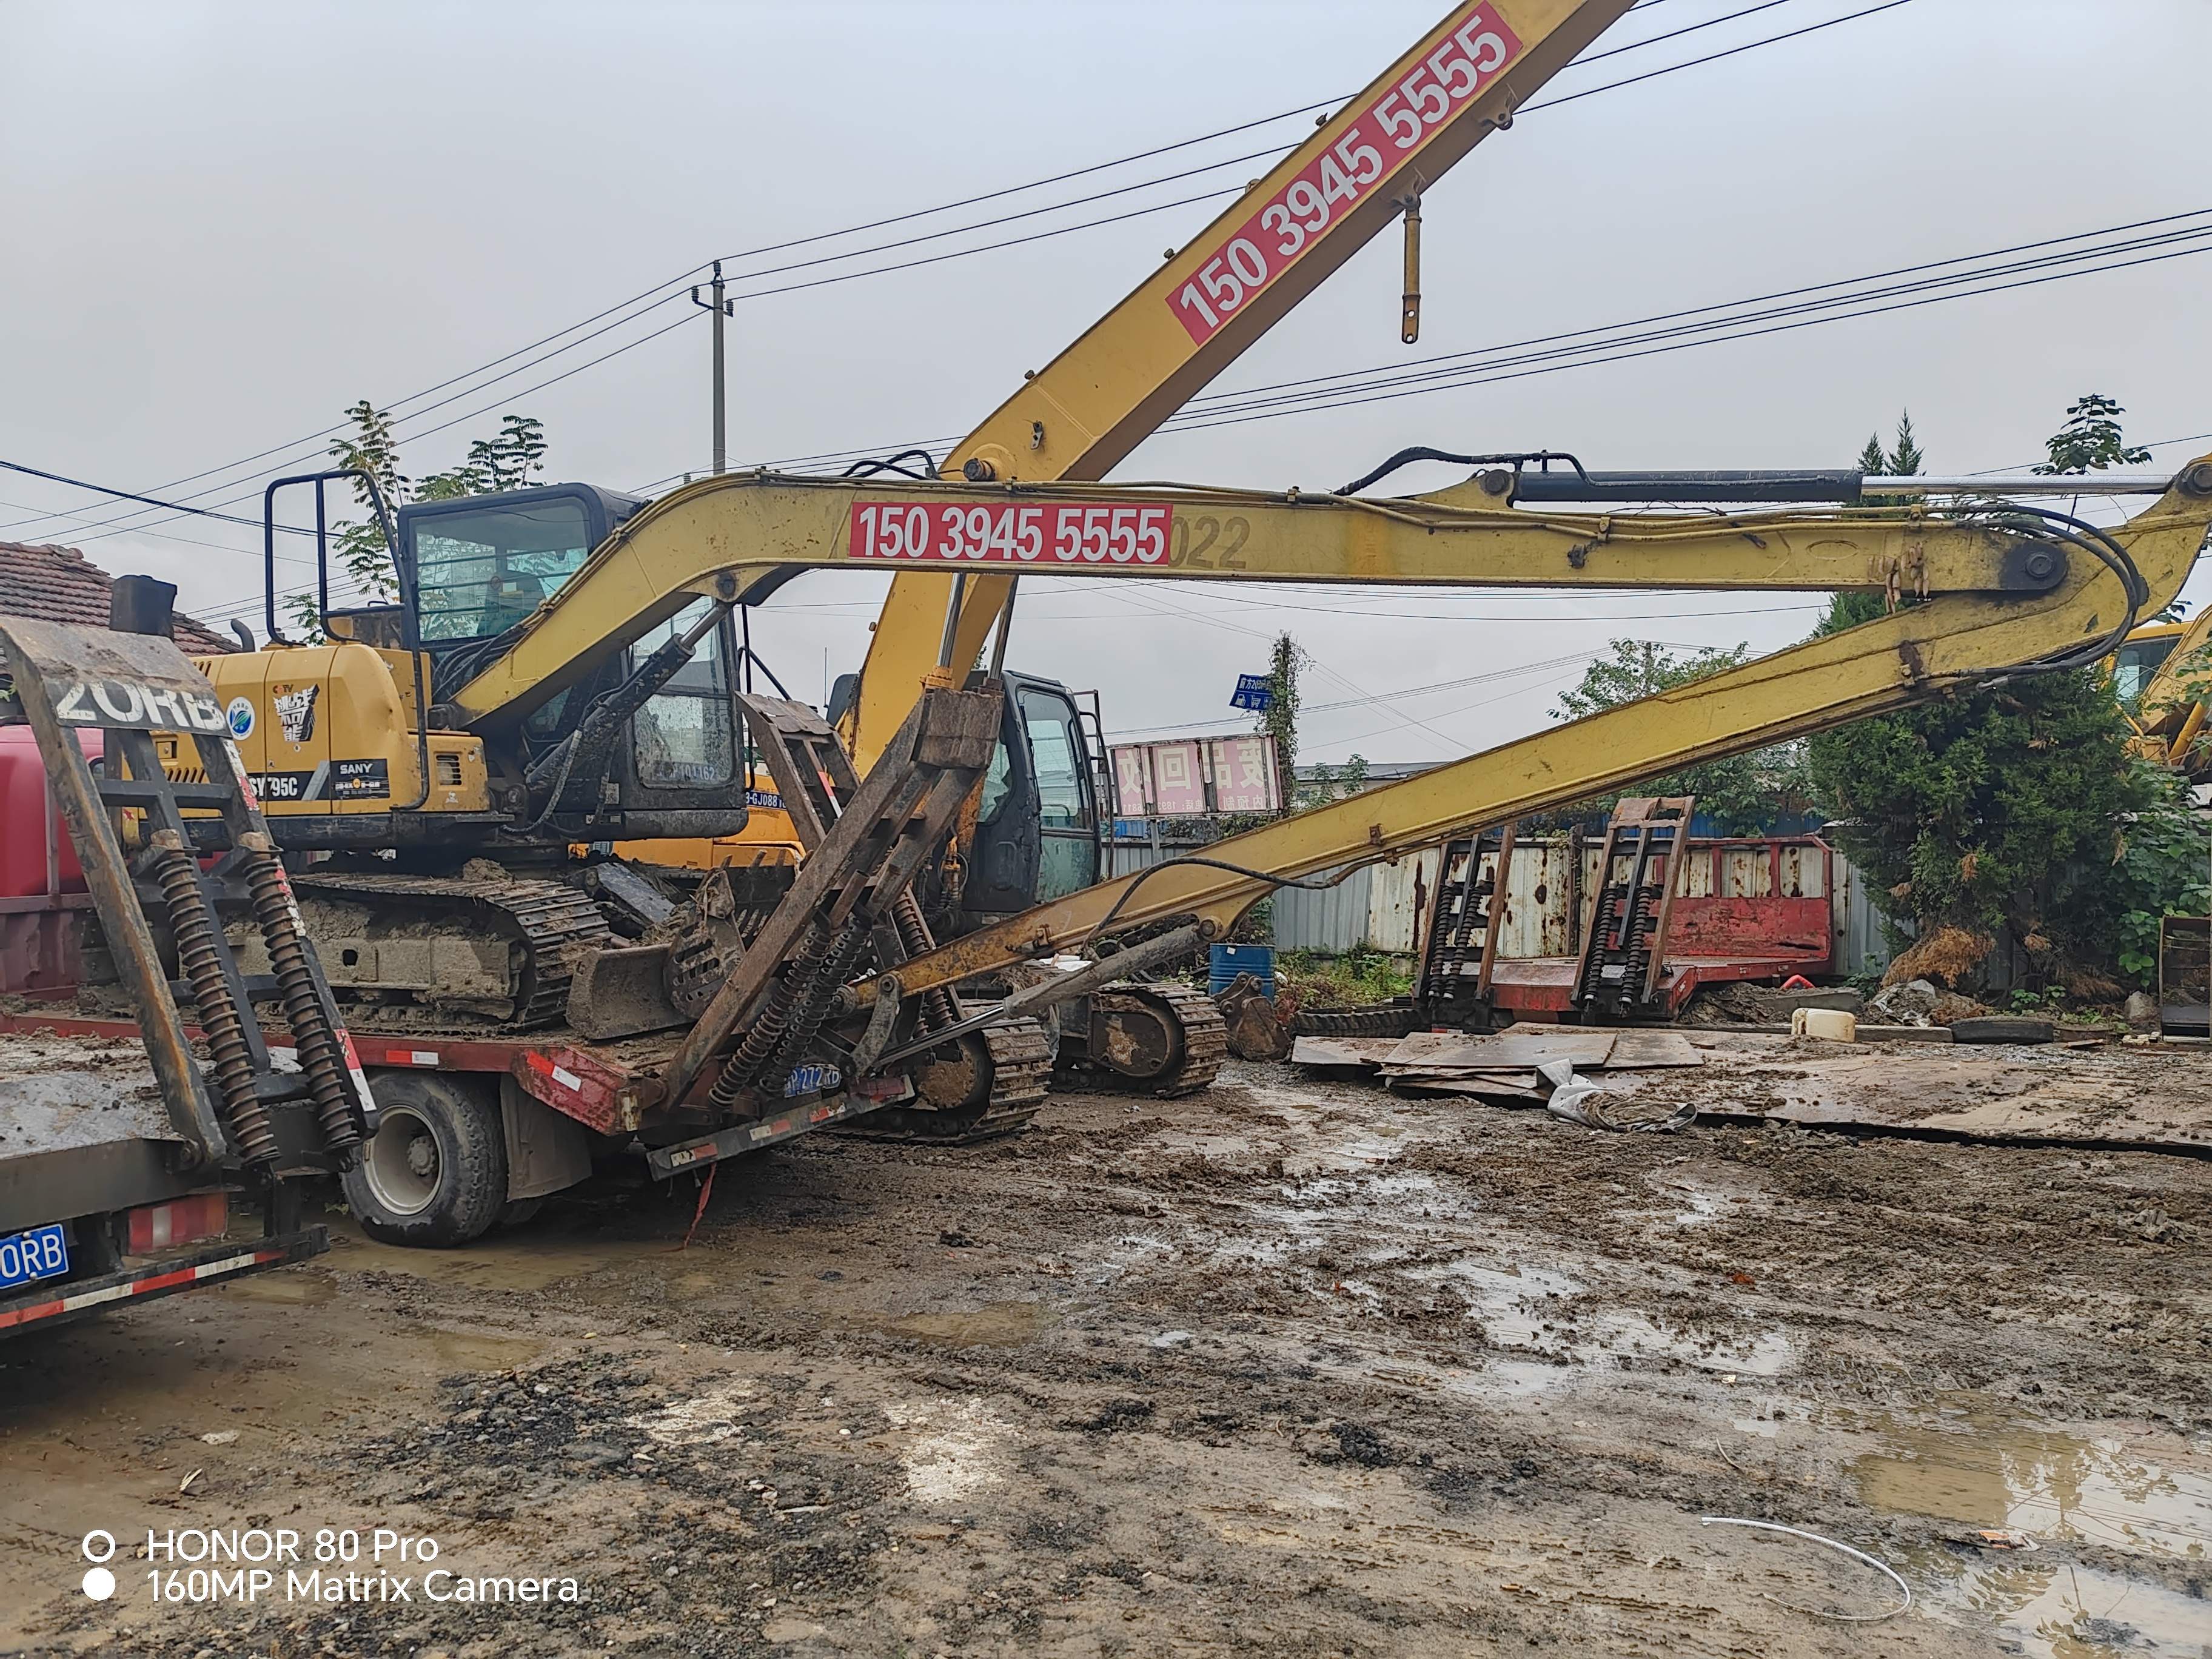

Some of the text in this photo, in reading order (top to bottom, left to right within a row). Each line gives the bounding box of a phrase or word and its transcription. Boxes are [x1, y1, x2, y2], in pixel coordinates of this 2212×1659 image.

[1180, 15, 1506, 327] 150 3945 5555
[859, 506, 1166, 563] 150 3945 5555
[340, 763, 373, 774] SANY
